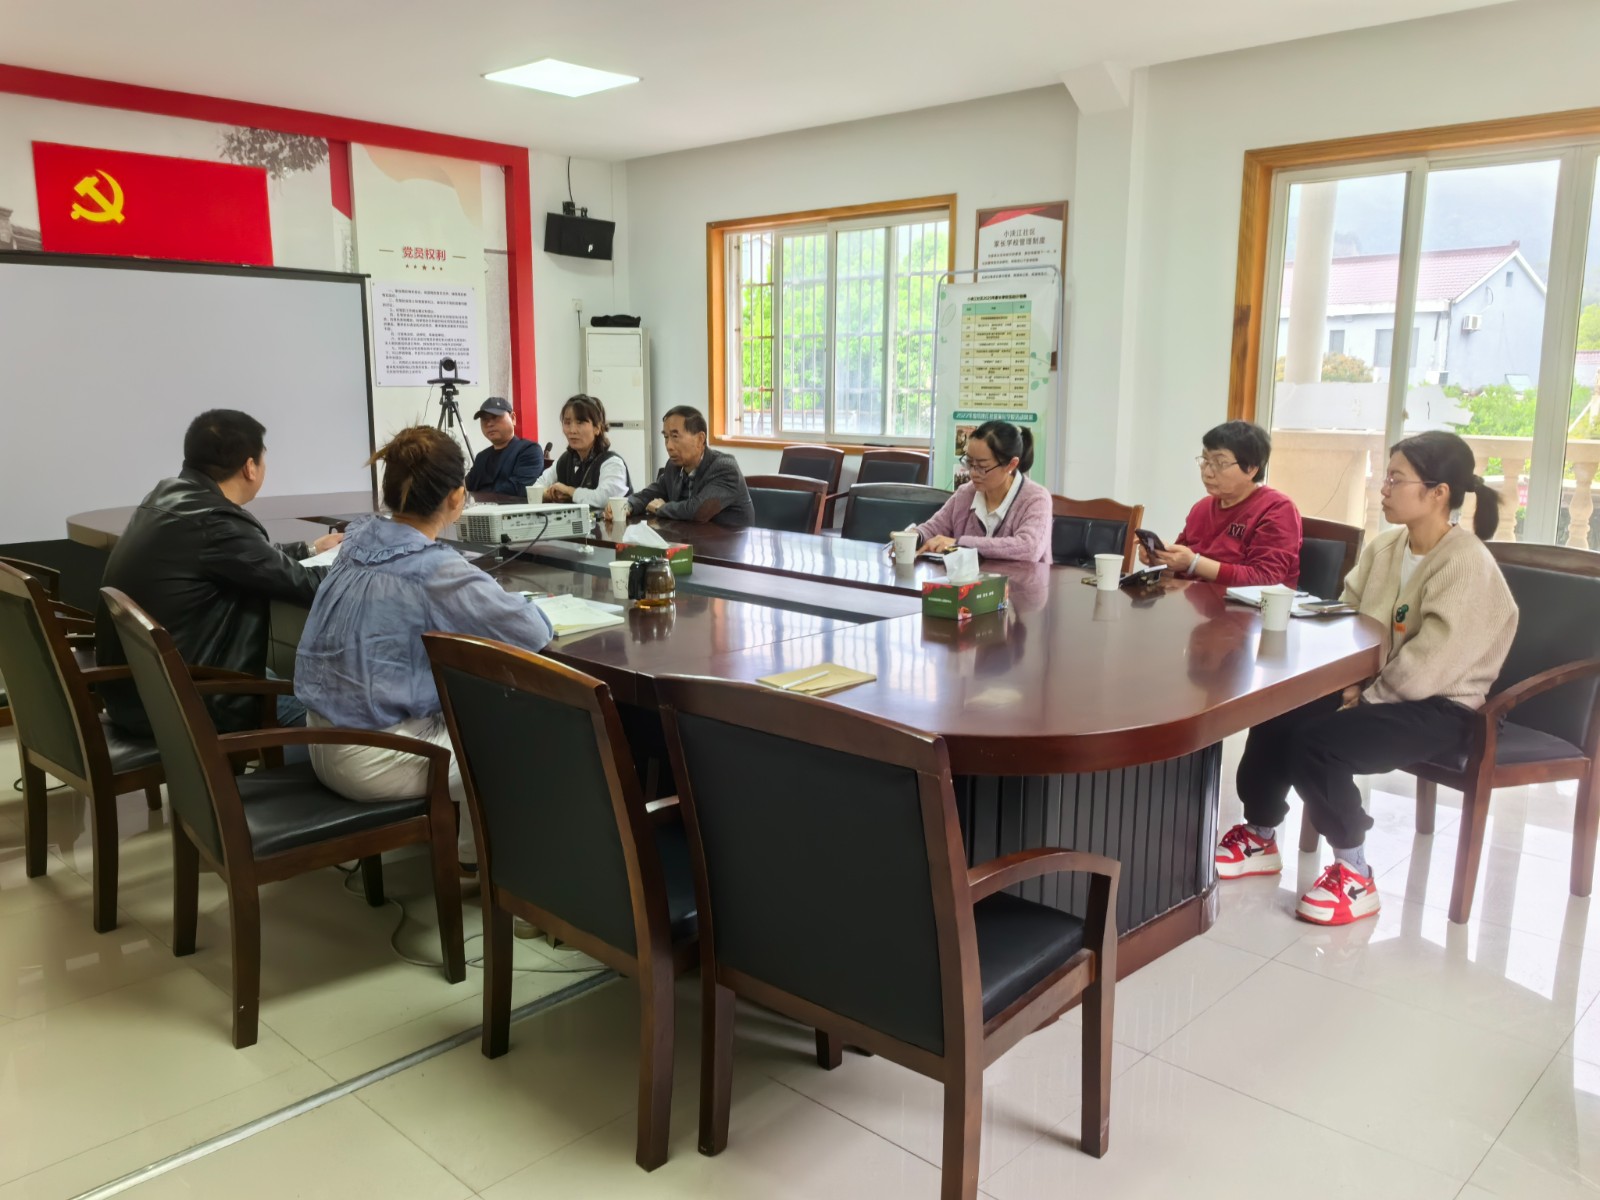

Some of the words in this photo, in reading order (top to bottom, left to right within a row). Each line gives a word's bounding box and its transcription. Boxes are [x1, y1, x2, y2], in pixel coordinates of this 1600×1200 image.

[993, 236, 1046, 248] 家长学校管理制度
[402, 246, 447, 261] 党员权利
